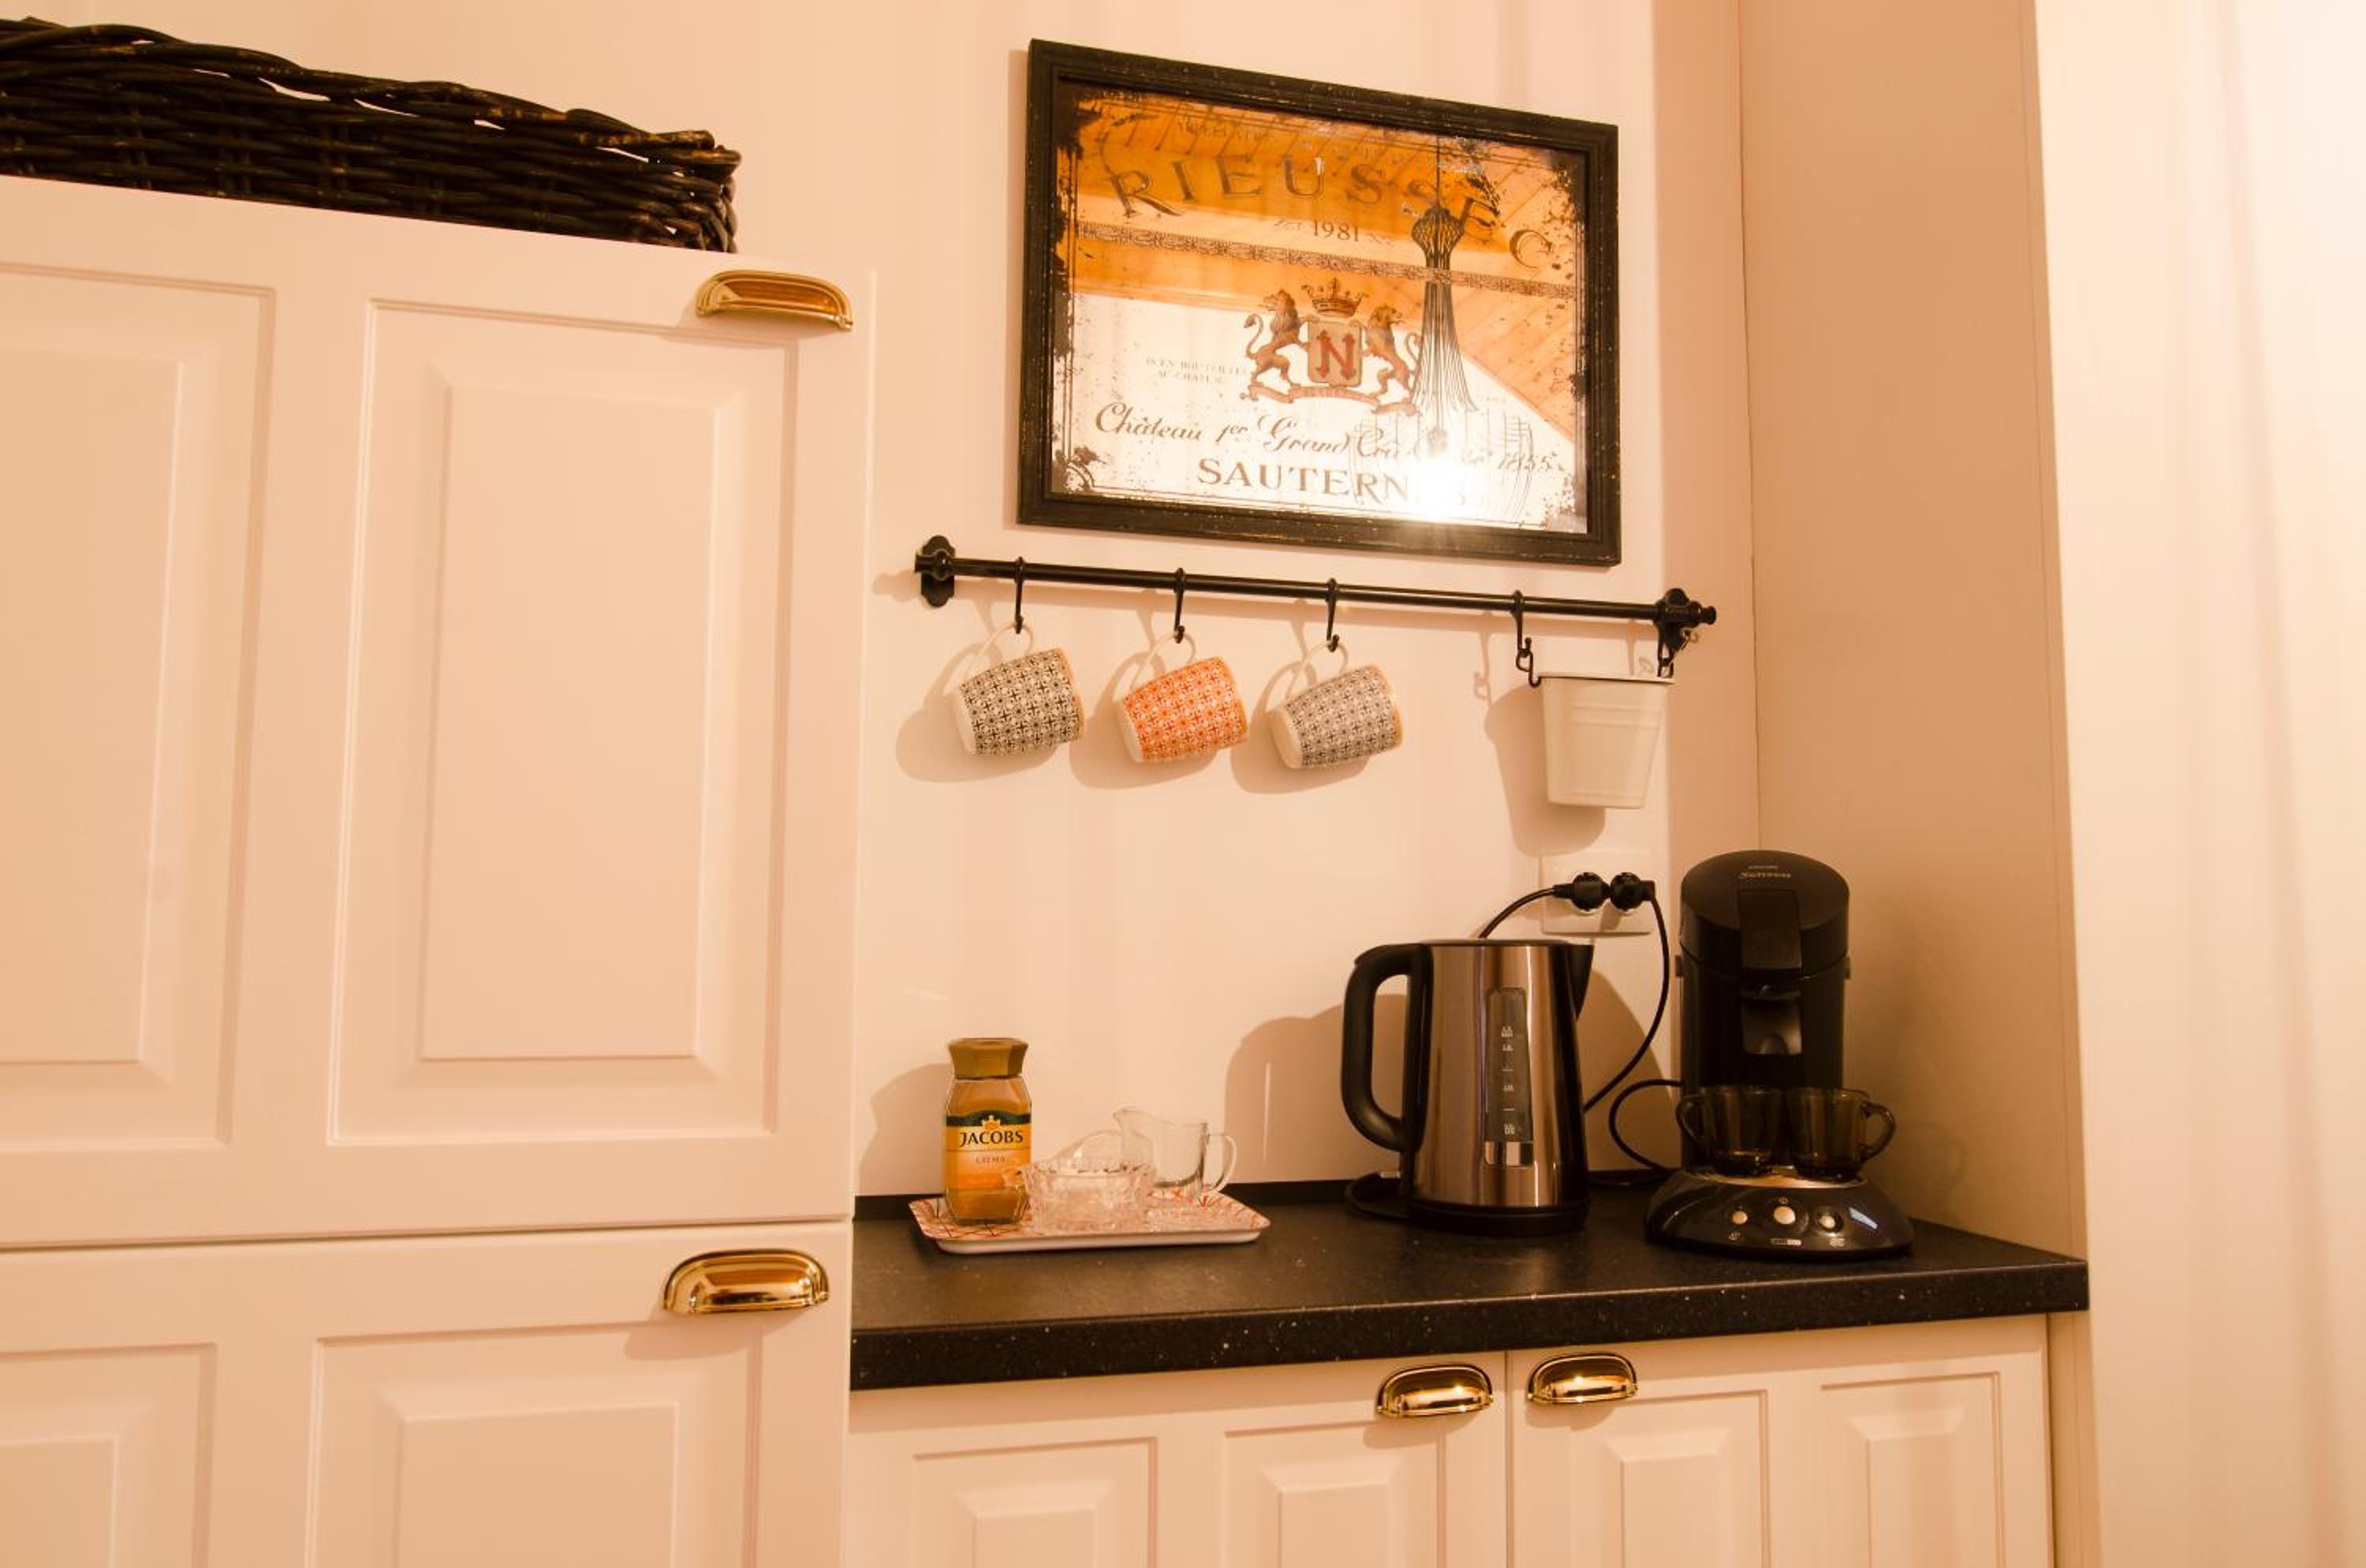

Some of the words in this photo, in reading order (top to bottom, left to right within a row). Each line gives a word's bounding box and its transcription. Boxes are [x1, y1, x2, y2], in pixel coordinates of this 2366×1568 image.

[1313, 219, 1360, 241] 1981
[1315, 330, 1355, 380] N
[1095, 401, 1202, 442] Château
[1257, 416, 1350, 454] Grand
[1197, 457, 1468, 511] SAUTERN
[958, 1129, 1023, 1148] JACOBS
